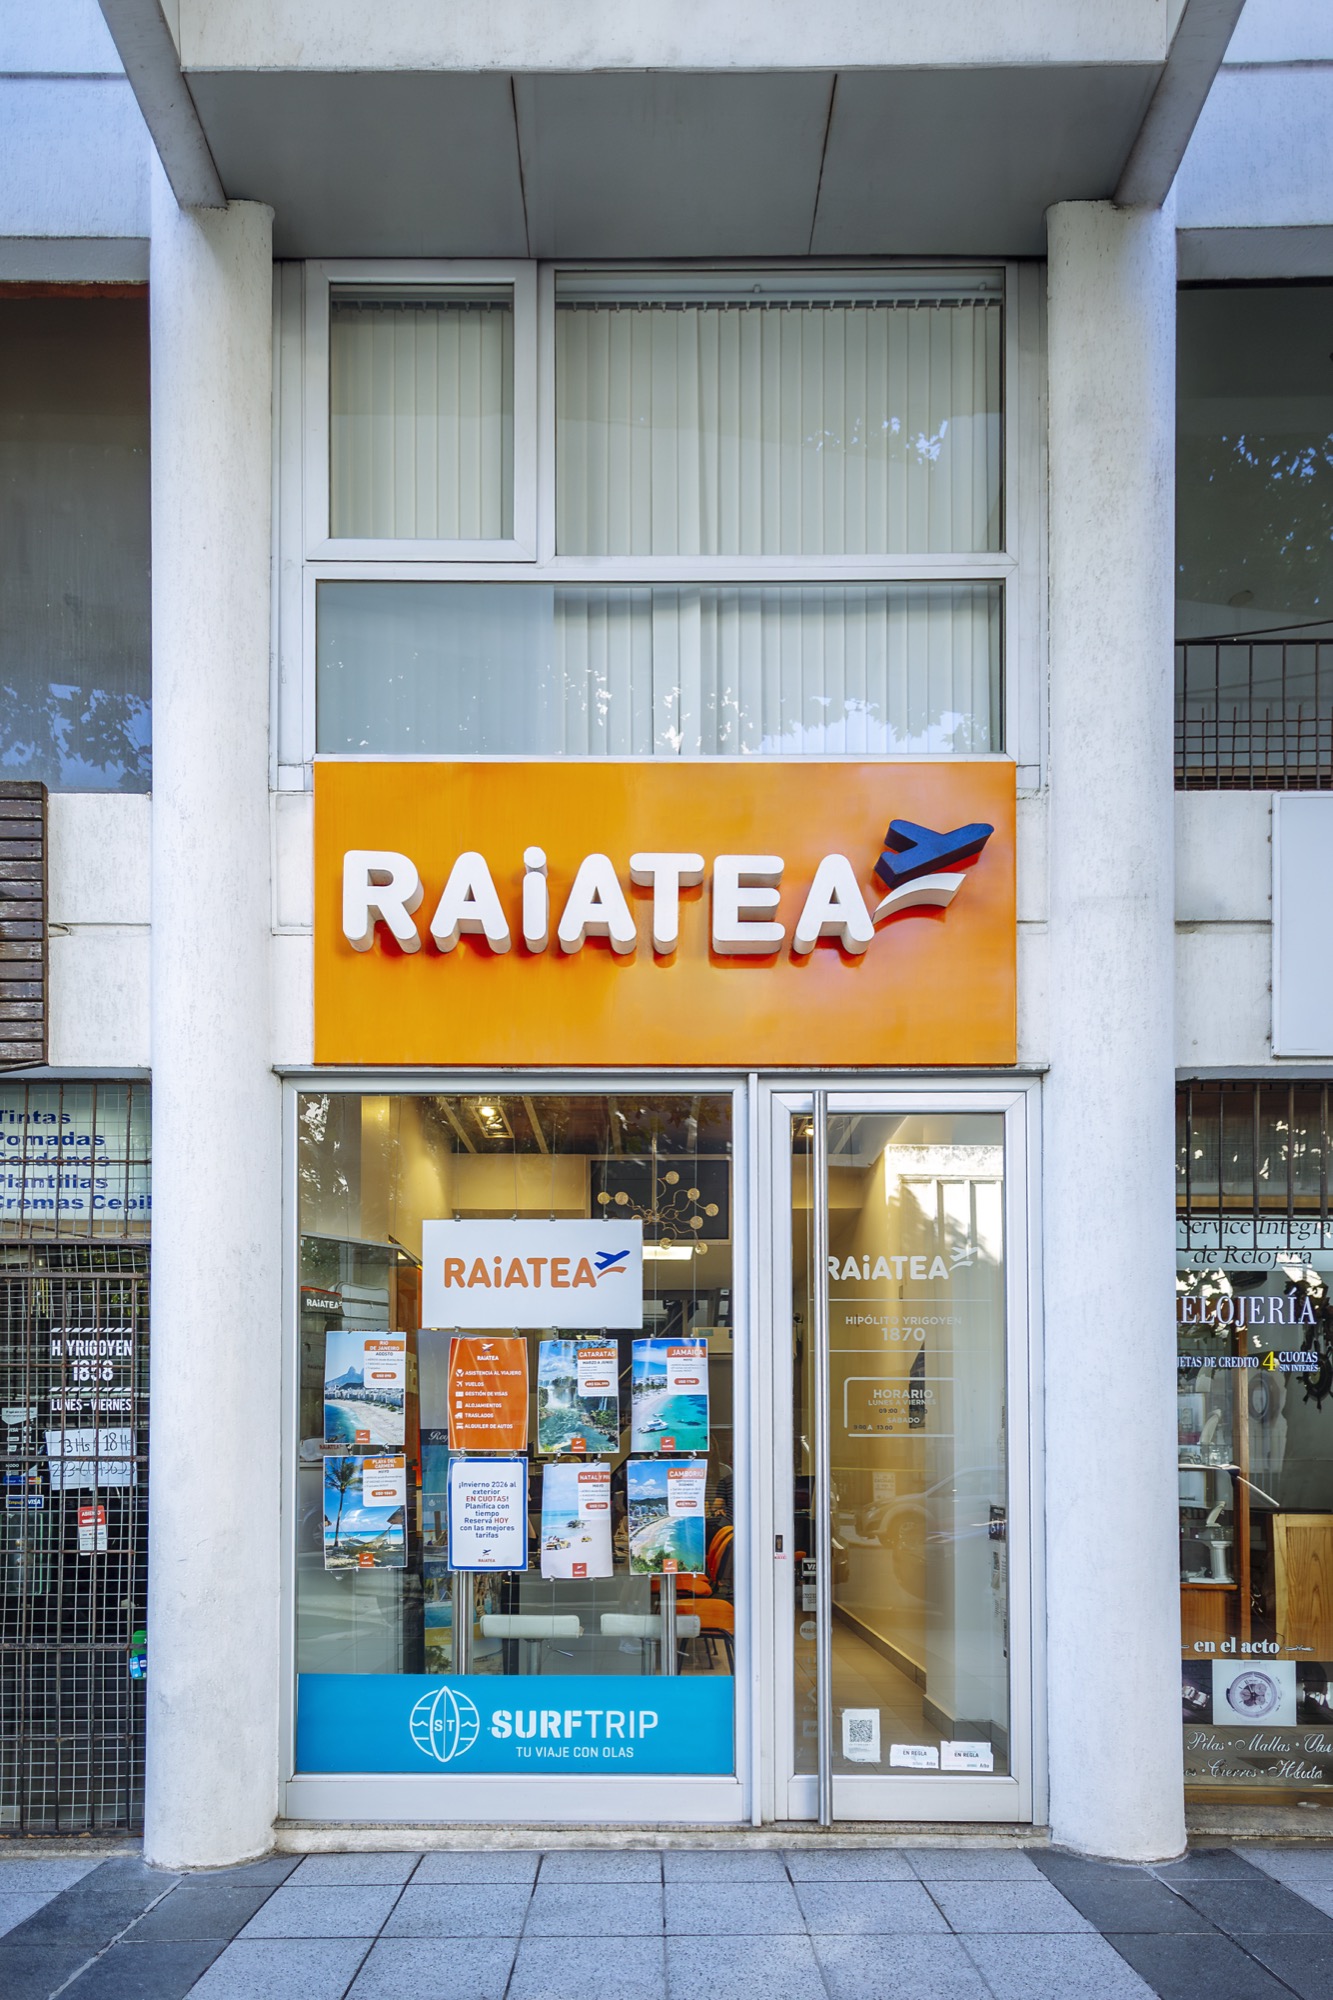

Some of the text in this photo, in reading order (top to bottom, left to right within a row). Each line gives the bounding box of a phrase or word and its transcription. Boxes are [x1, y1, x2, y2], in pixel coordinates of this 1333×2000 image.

[1179, 1216, 1251, 1235] Service
[1193, 1245, 1313, 1270] de Relojería
[1177, 1286, 1318, 1327] ELOJERÍA
[845, 1314, 963, 1325] HIPÓLITO YRIGOYEN
[881, 1327, 926, 1342] 1870
[51, 1339, 132, 1356] H. YRIGOYEN
[1204, 1356, 1216, 1368] DE
[1218, 1356, 1259, 1368] CREDITO
[1262, 1351, 1276, 1371] 4
[1278, 1351, 1318, 1363] CUOTAS
[71, 1359, 114, 1381] 1858
[1279, 1364, 1290, 1372] SIN
[873, 1389, 933, 1399] HORARIO
[102, 1432, 118, 1452] 18
[458, 1481, 490, 1489] ¡Invierno
[1193, 1636, 1281, 1654] en el acto
[1187, 1731, 1225, 1751] Pilas
[1235, 1733, 1291, 1752] Mallas
[516, 1746, 634, 1758] TU VIAJE CON OLAS
